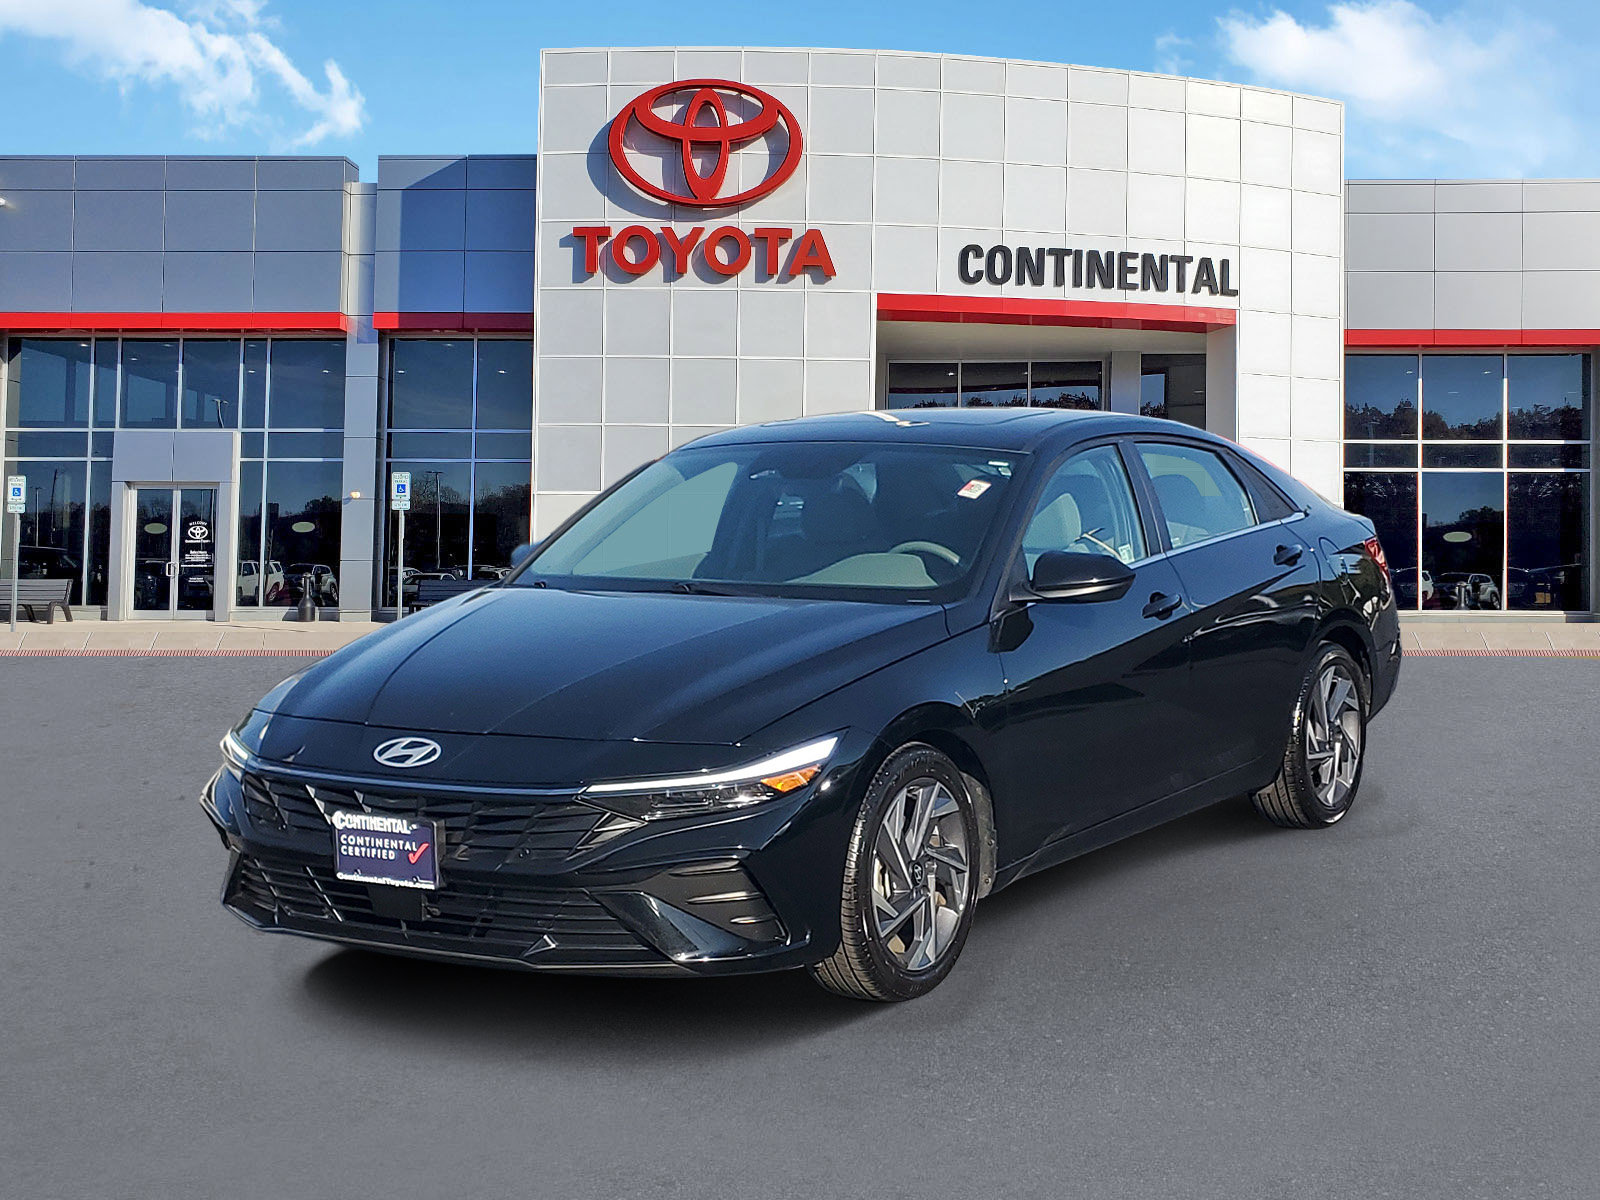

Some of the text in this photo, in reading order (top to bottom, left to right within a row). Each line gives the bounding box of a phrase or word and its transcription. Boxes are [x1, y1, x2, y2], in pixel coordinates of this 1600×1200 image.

[572, 225, 837, 277] TOYOTA
[958, 243, 1239, 297] CONTINENTAL
[332, 811, 411, 834] CONTINENTAL
[340, 834, 417, 851] CONTINENTAL
[340, 845, 396, 860] CERTIFIED
